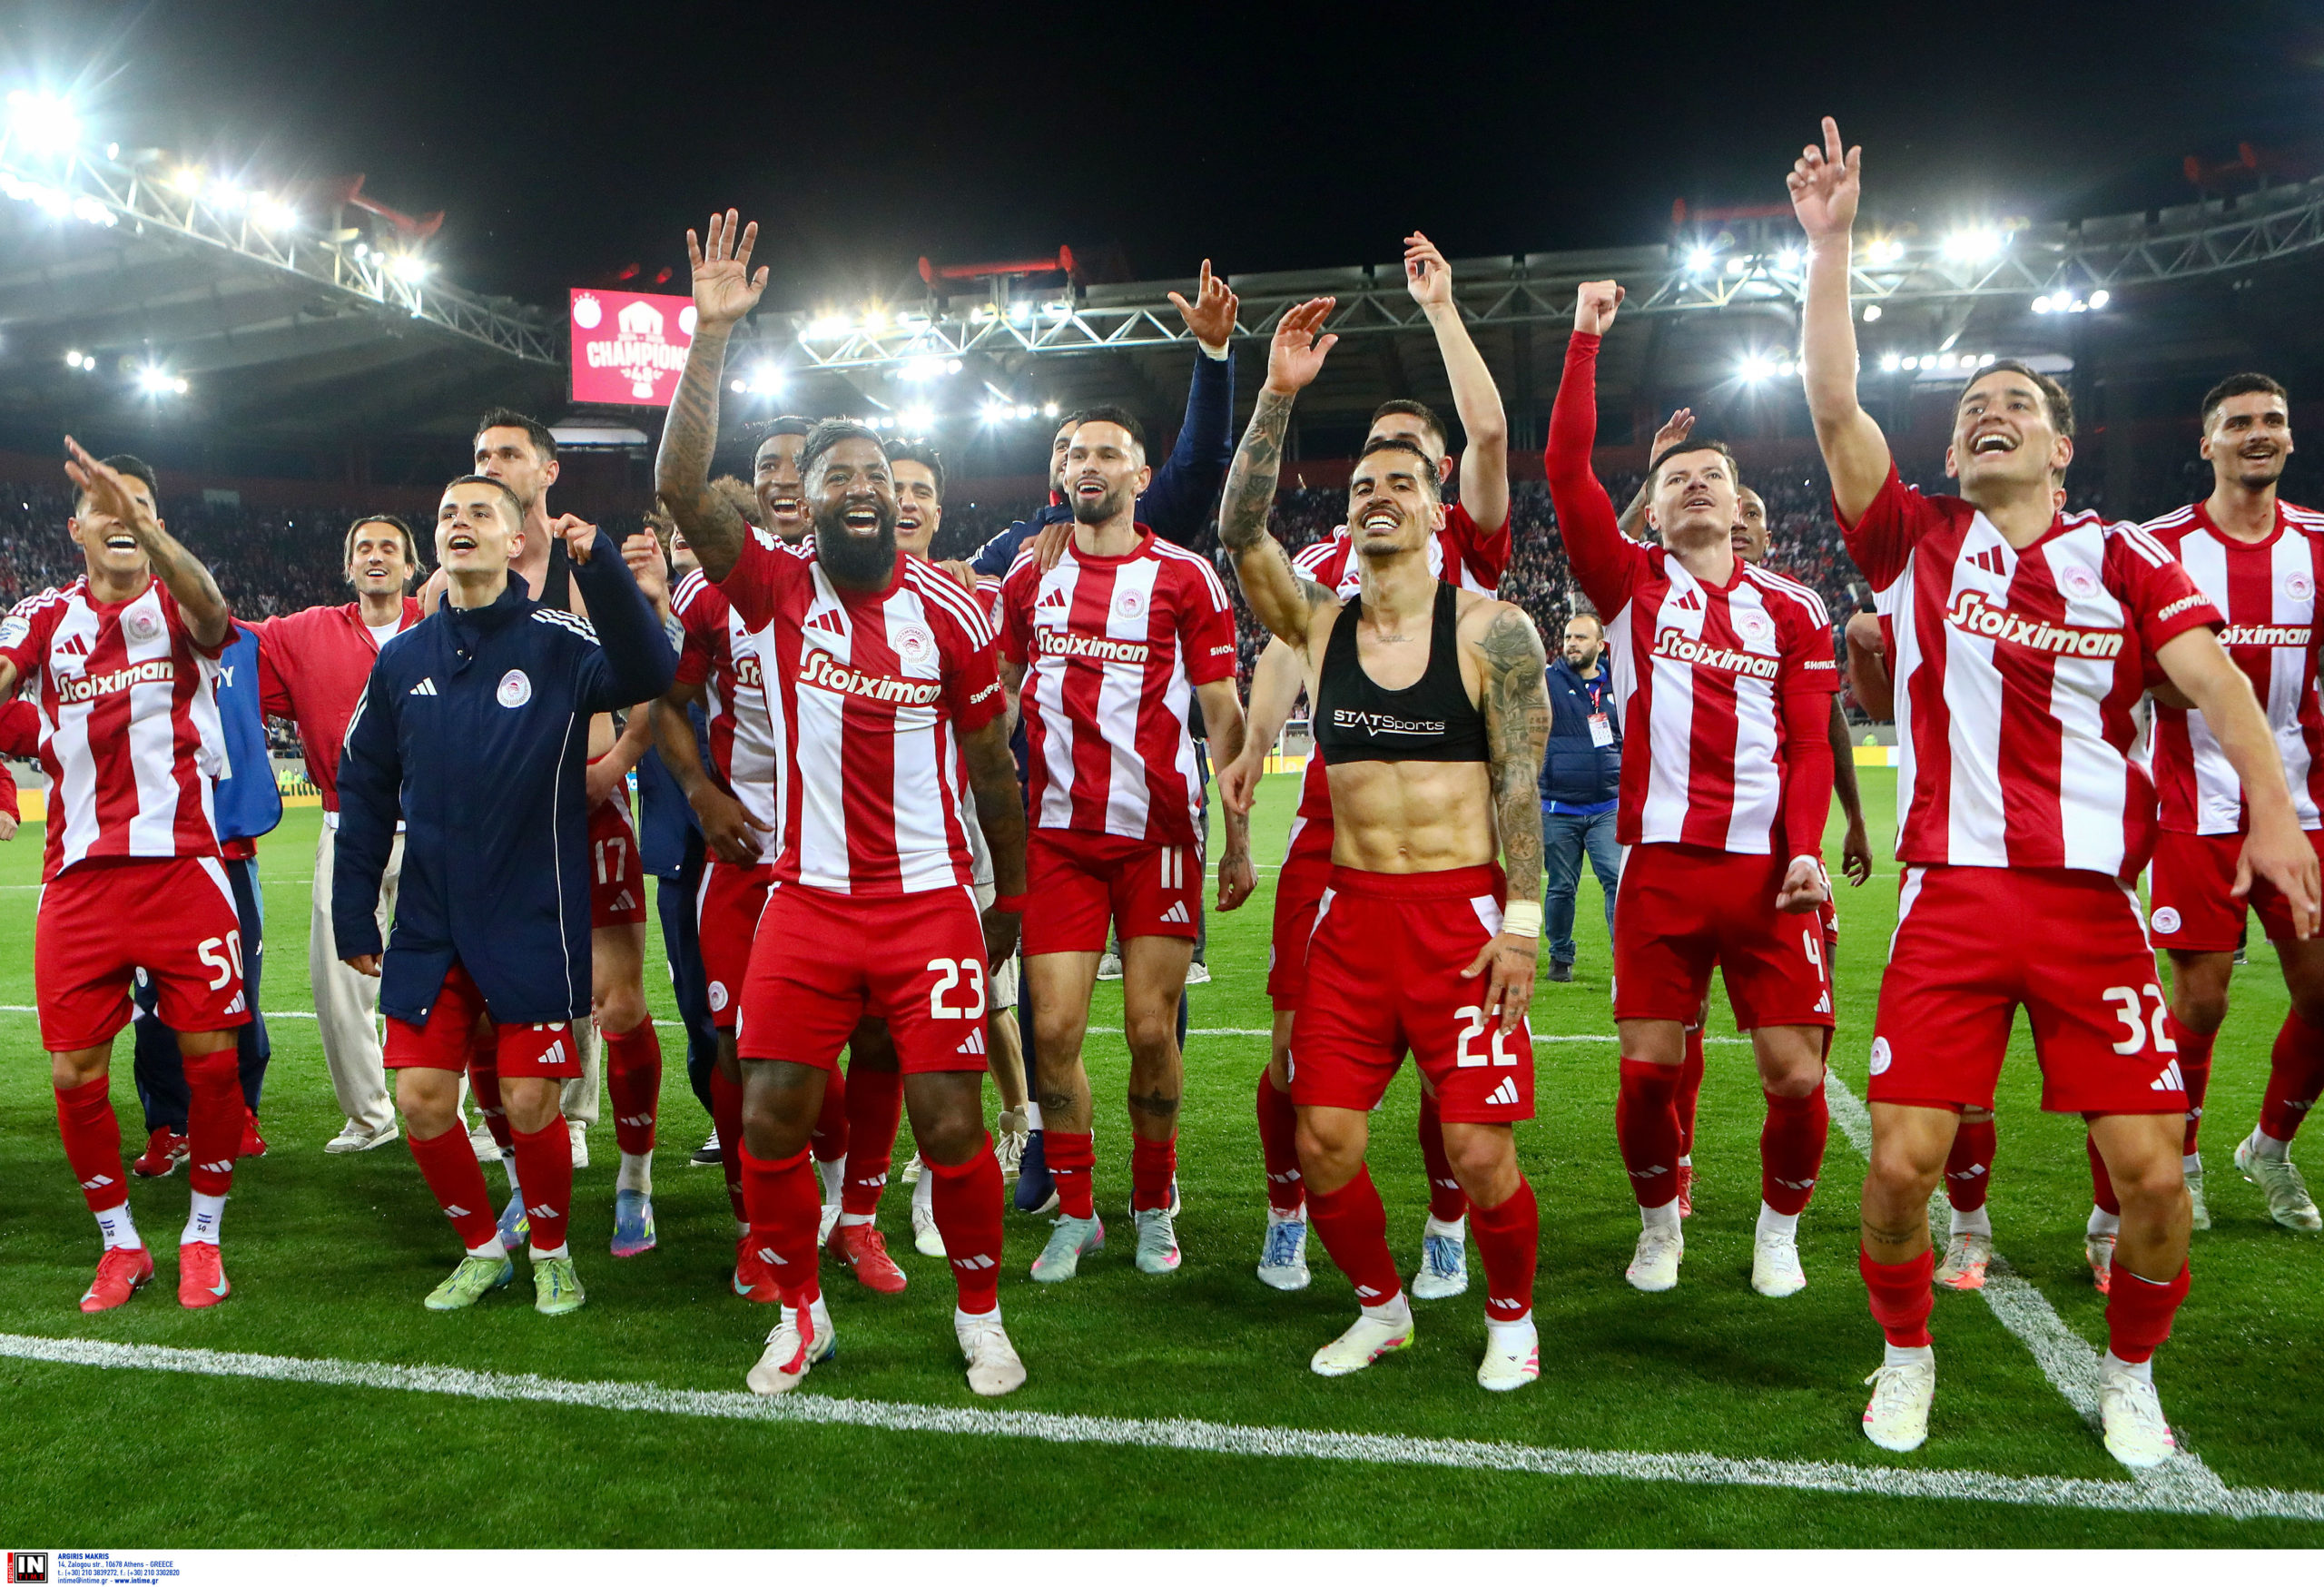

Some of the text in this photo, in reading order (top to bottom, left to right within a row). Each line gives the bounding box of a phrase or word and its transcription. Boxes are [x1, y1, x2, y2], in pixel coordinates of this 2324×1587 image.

[1039, 627, 1149, 662] Stoiximan
[1949, 593, 2123, 657] Stoiximan
[800, 653, 941, 705] Stoiximan
[1653, 629, 1779, 679] Stoiximan
[59, 661, 174, 703] Stoiximan
[596, 837, 626, 884] 17
[1161, 845, 1183, 889] 11
[198, 930, 243, 991] 50
[1803, 930, 1825, 982] 4
[927, 958, 986, 1020] 23
[1454, 1004, 1518, 1068] 22
[2102, 983, 2178, 1056] 32
